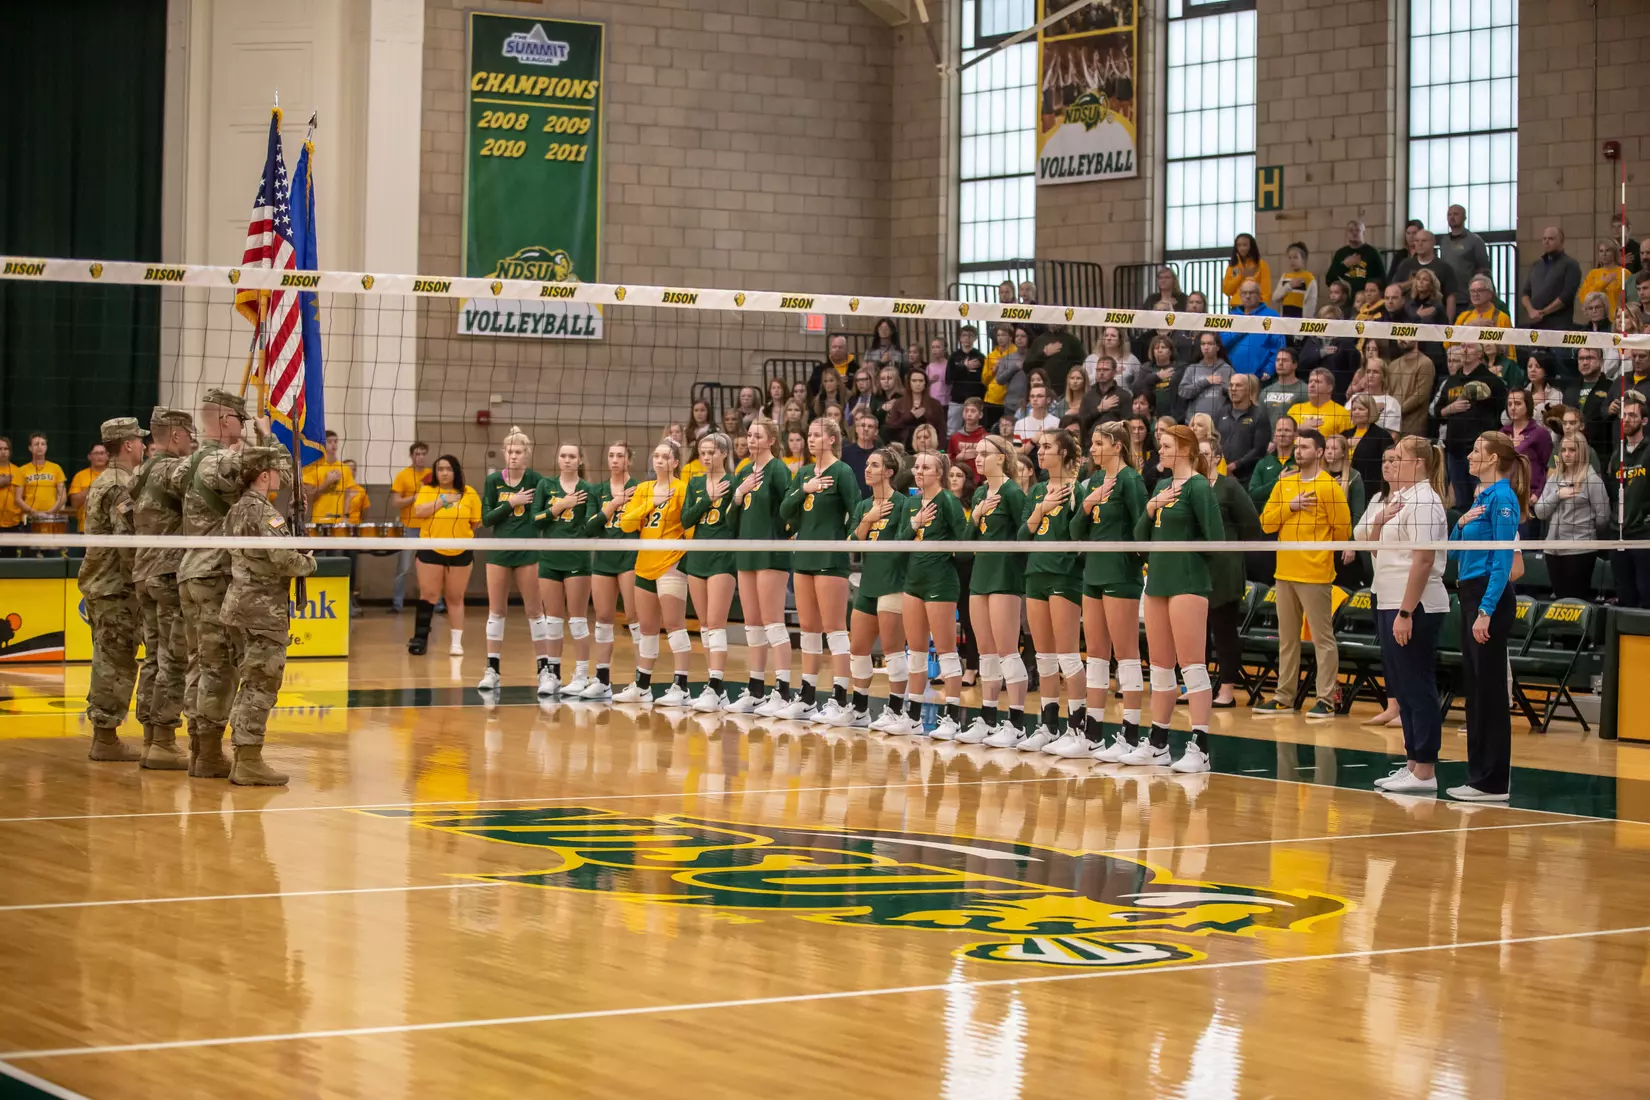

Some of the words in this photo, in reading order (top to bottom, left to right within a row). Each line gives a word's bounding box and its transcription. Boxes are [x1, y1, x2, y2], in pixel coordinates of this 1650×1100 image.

[506, 40, 567, 58] SUMMIT
[520, 56, 554, 64] LEAGUE
[471, 71, 600, 100] CHAMPIONS
[477, 111, 530, 131] 2008
[543, 115, 592, 135] 2009
[1063, 104, 1101, 124] NDSU
[479, 138, 527, 158] 2010
[544, 143, 589, 162] 2011
[1040, 149, 1133, 179] VOLLEYBALL
[1258, 169, 1280, 208] H
[497, 261, 555, 281] NDSU
[3, 262, 46, 276] BISON
[144, 268, 186, 282] BISON
[280, 274, 321, 288] BISON
[412, 280, 452, 293] BISON
[540, 285, 577, 298] BISON
[661, 291, 699, 305] BISON
[779, 297, 814, 310] BISON
[892, 302, 926, 315] BISON
[1000, 307, 1033, 320] BISON
[1104, 312, 1135, 325] BISON
[1204, 317, 1234, 329] BISON
[1299, 322, 1328, 333] BISON
[1390, 326, 1418, 337] BISON
[1478, 330, 1504, 341] BISON
[1562, 334, 1588, 345] BISON
[465, 310, 597, 336] VOLLEYBALL
[803, 493, 814, 512] 8
[1544, 607, 1583, 622] BISON
